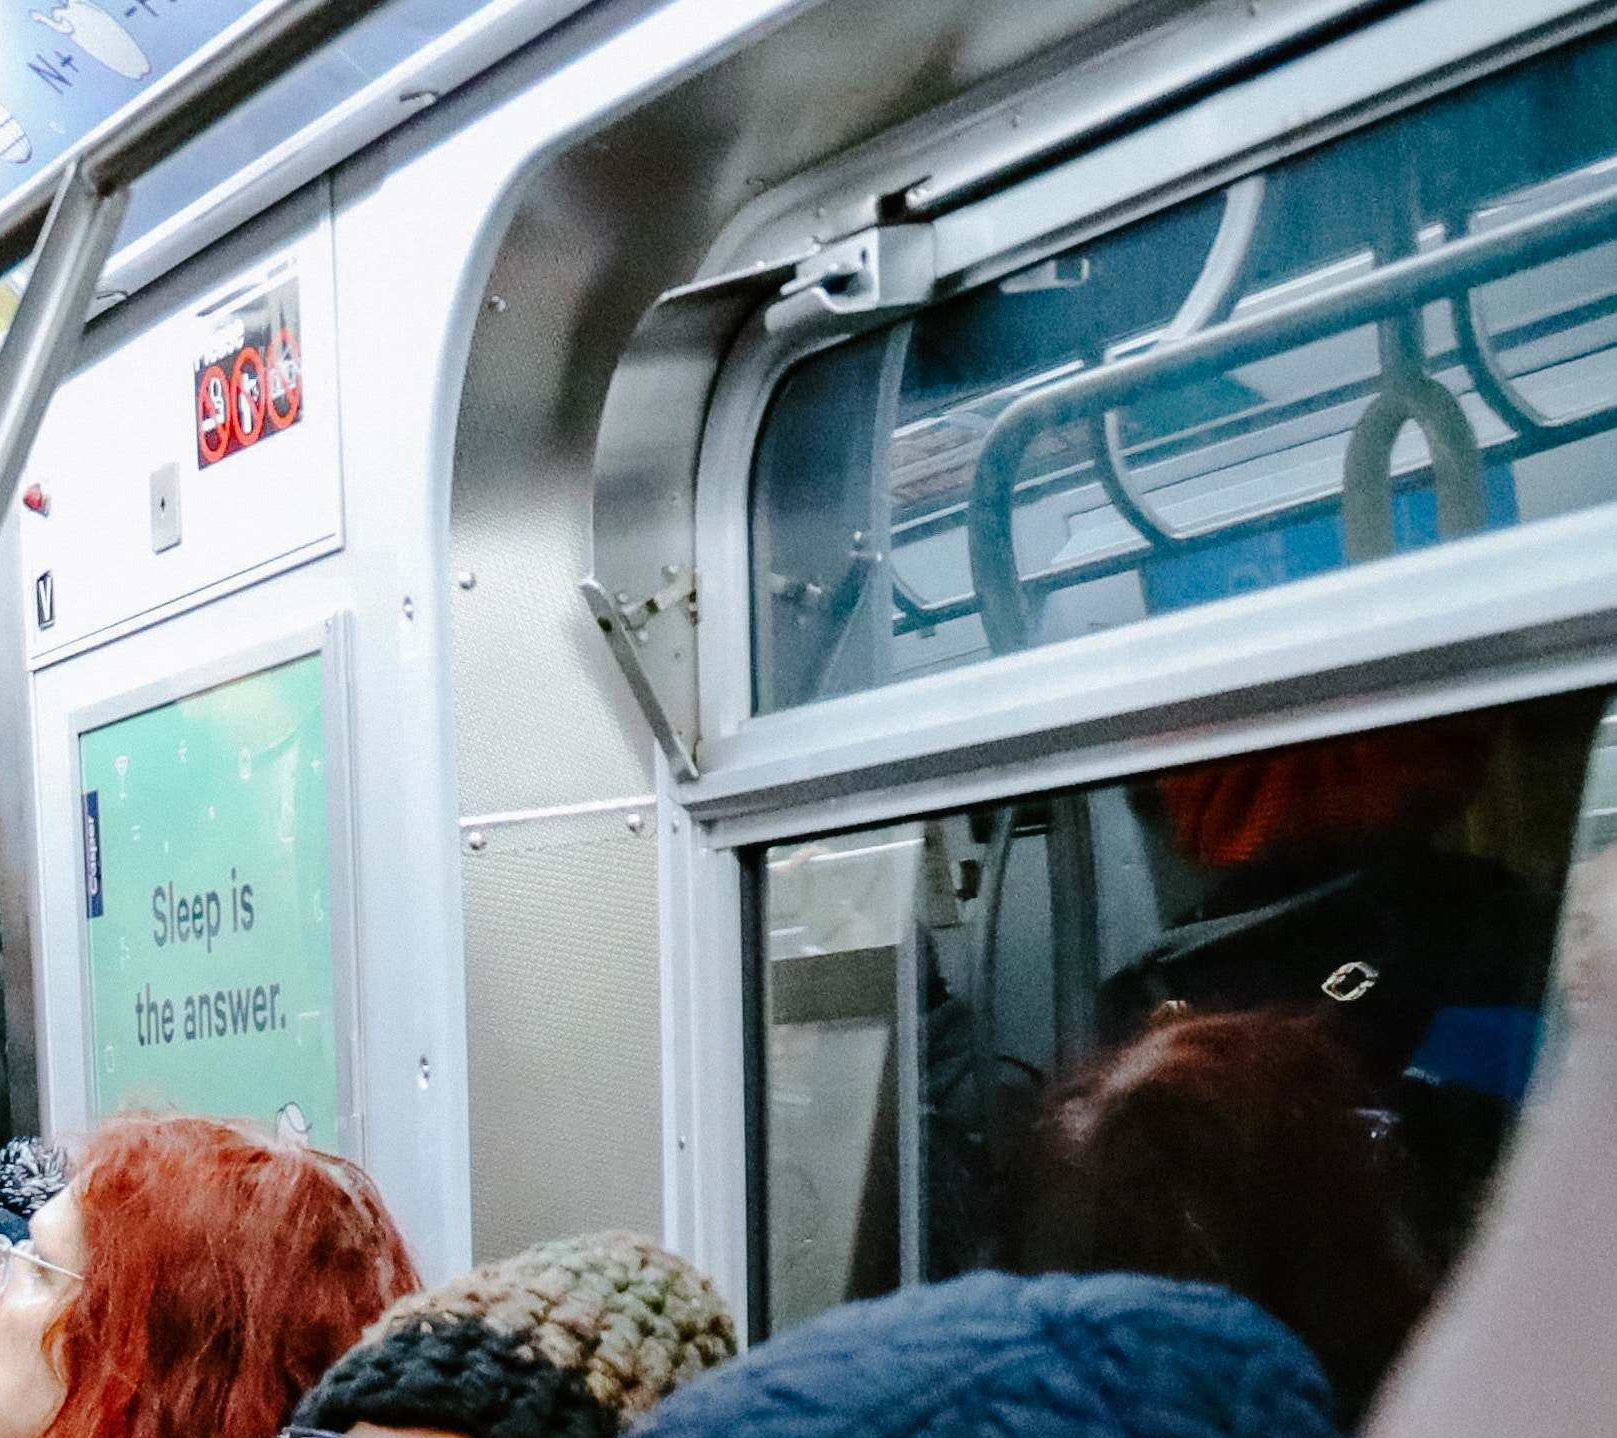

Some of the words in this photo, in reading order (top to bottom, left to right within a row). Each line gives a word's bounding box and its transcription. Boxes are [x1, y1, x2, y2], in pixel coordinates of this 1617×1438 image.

[152, 880, 221, 953] Sleep
[231, 867, 255, 933] is
[135, 983, 175, 1046] the
[183, 982, 286, 1042] answer.
